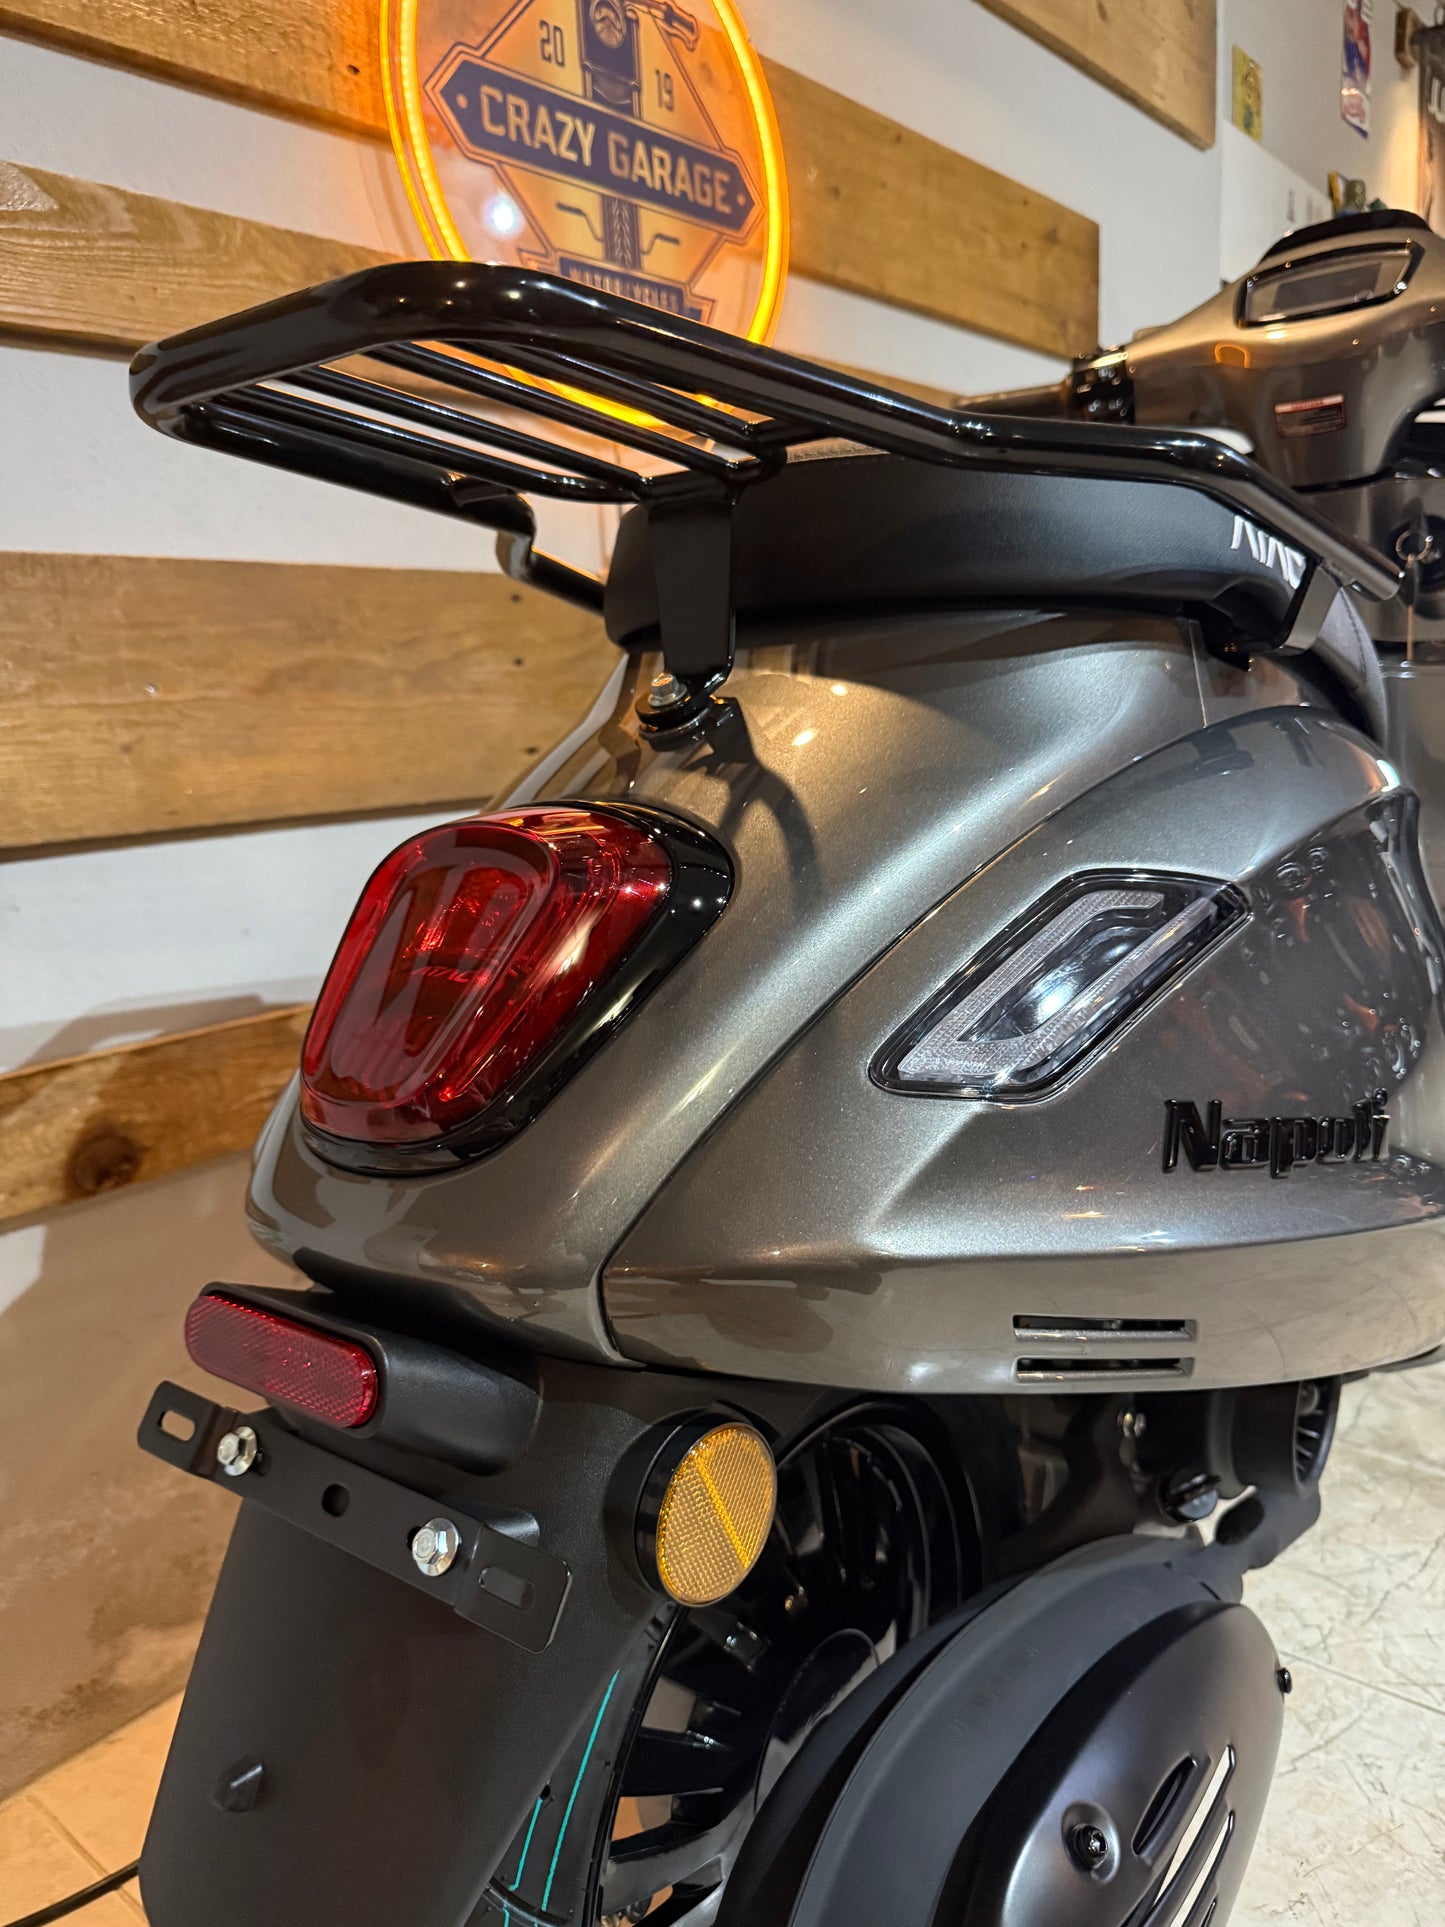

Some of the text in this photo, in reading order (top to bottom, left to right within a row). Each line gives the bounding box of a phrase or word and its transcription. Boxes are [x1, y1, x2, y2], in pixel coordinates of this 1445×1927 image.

[538, 19, 566, 68] 20
[654, 68, 676, 112] 19
[479, 84, 733, 216] CRAZY GARAGE
[1162, 1087, 1391, 1179] Napoli
